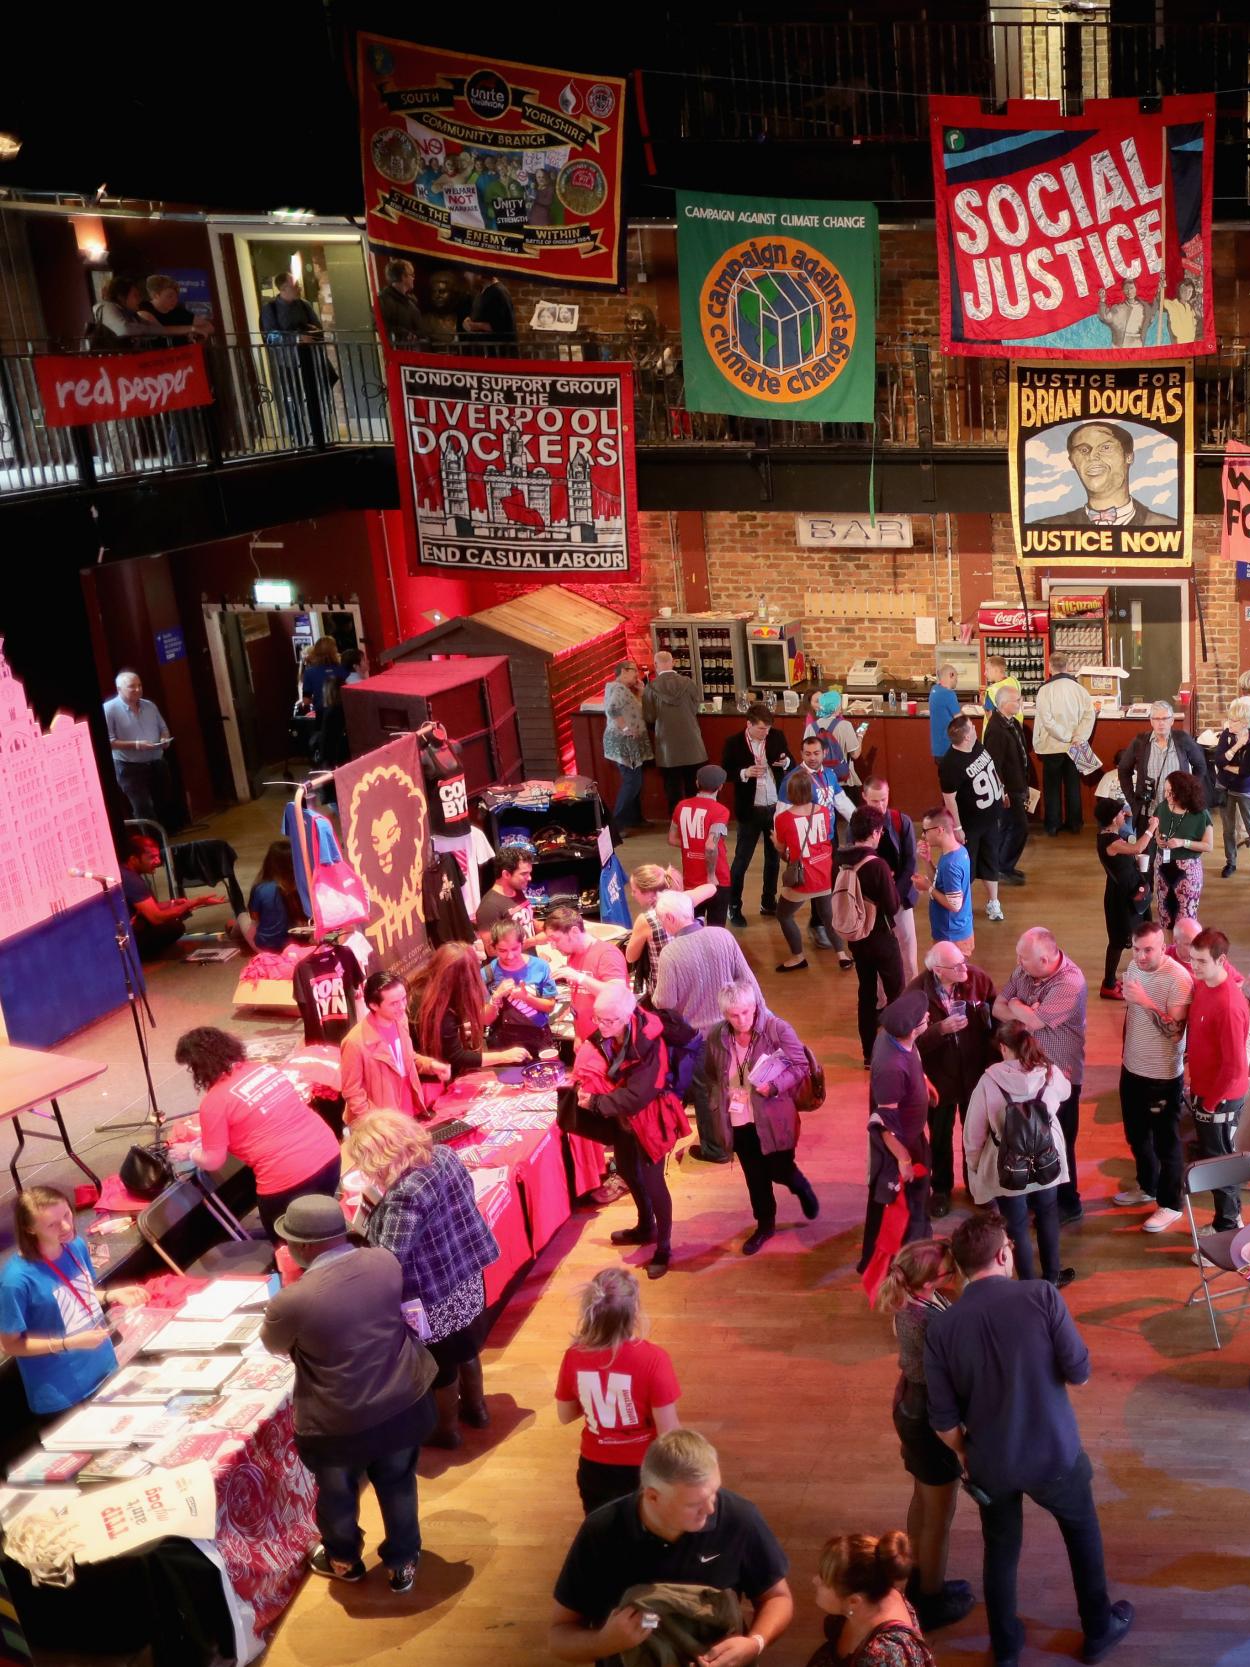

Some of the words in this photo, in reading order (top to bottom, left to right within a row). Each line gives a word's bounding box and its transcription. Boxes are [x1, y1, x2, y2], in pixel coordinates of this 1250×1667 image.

[400, 92, 440, 104] SOUTH
[470, 87, 505, 102] unite
[422, 113, 493, 144] COMMUNITY
[498, 133, 546, 146] BRANCH
[524, 104, 586, 143] YORKSHIRE
[391, 193, 426, 215] STILL
[429, 207, 449, 223] THE
[448, 195, 473, 205] NOT
[493, 199, 524, 210] UNITY
[954, 136, 1163, 255] SOCIAL
[506, 209, 516, 217] IS
[685, 205, 735, 222] CAMPAIGN
[737, 212, 776, 225] AGAINST
[780, 214, 819, 228] CLIMATE
[823, 216, 866, 228] CHANGE
[466, 230, 507, 245] ENEMY
[536, 229, 581, 240] WITHIN
[963, 208, 1163, 320] JUSTICE
[707, 241, 788, 319] campaign
[791, 248, 853, 323] against
[710, 323, 781, 395] climate
[787, 326, 850, 395] change
[55, 367, 114, 409] red
[117, 365, 194, 413] pepper
[405, 370, 478, 388] LONDON
[481, 377, 552, 393] SUPPORT
[556, 380, 617, 395] GROUP
[1022, 371, 1115, 388] JUSTICE
[1138, 372, 1181, 388] FOR
[470, 389, 505, 404] FOR
[513, 392, 549, 406] THE
[1021, 387, 1082, 428] BRIAN
[1089, 387, 1183, 424] DOUGLAS
[407, 398, 618, 435] LIVERPOOL
[411, 425, 618, 467] DOCKERS
[808, 519, 905, 541] BAR
[1022, 530, 1113, 552] JUSTICE
[1121, 531, 1183, 553] NOW
[424, 544, 460, 562] END
[466, 548, 546, 568] CASUAL
[550, 552, 625, 568] LABOUR
[966, 748, 992, 779] ORIGINA
[972, 759, 1002, 810] 90
[680, 806, 707, 849] M
[794, 812, 827, 858] M
[316, 995, 348, 1019] YN
[577, 1371, 639, 1435] M
